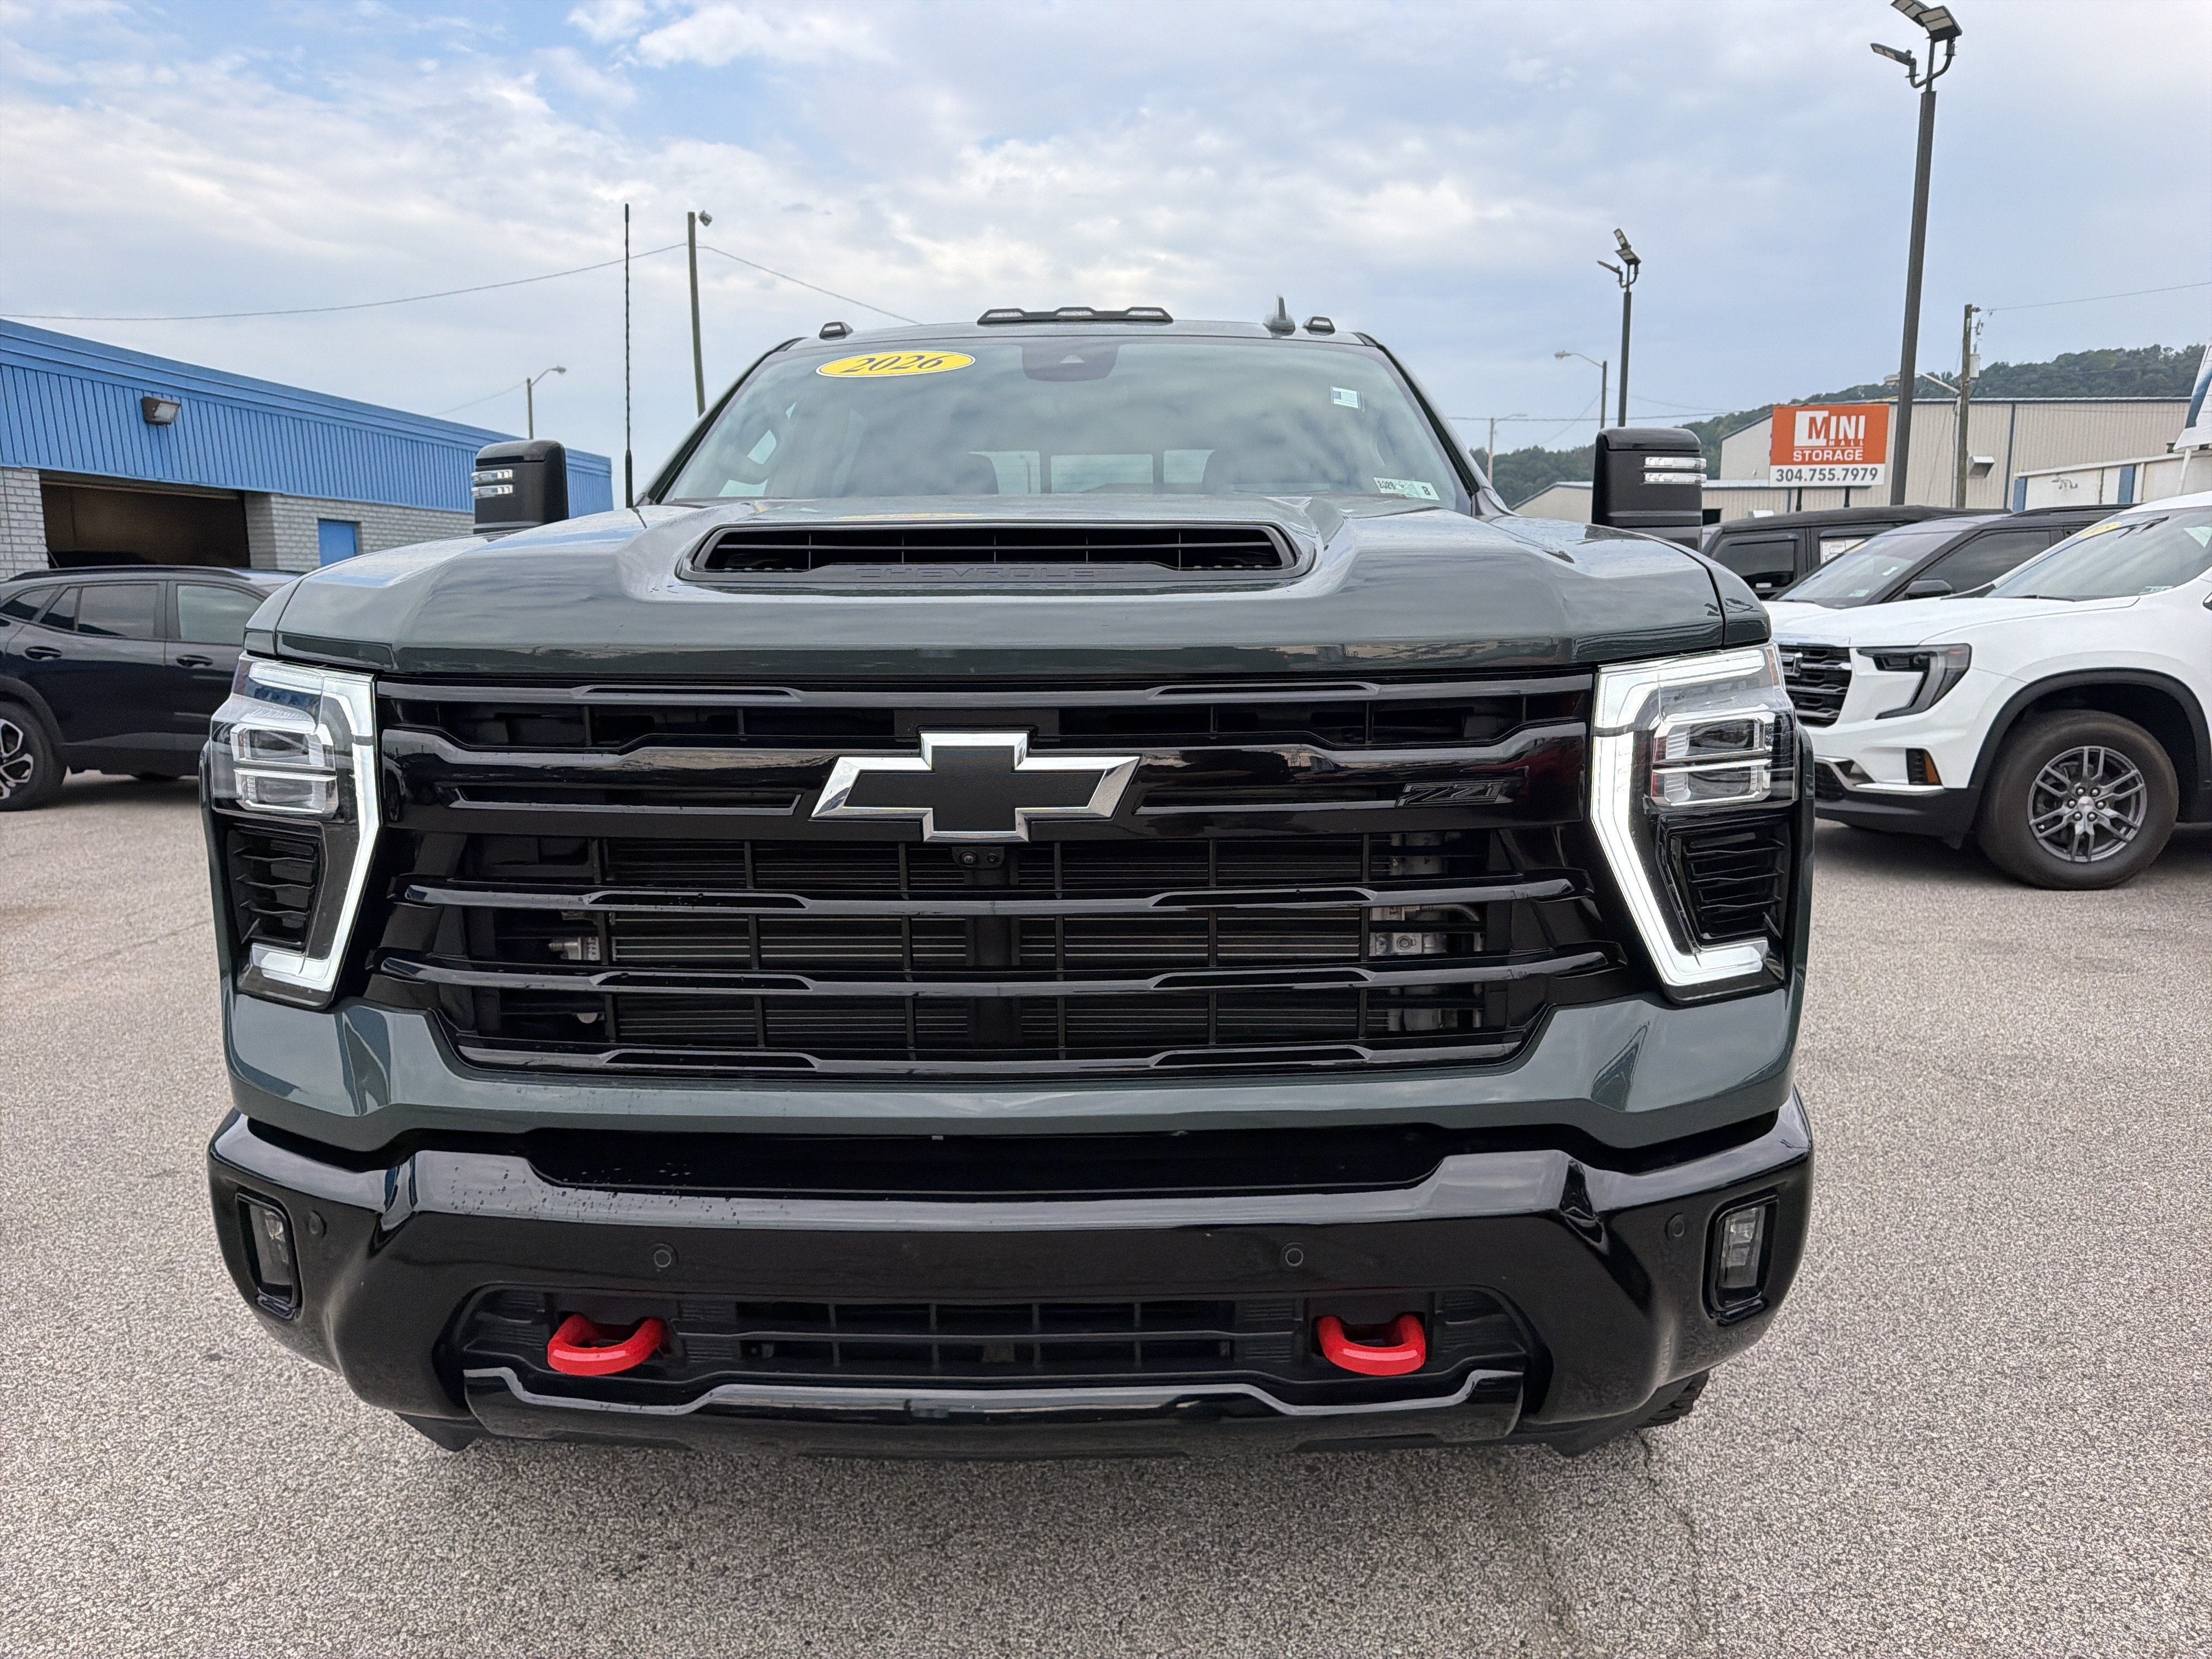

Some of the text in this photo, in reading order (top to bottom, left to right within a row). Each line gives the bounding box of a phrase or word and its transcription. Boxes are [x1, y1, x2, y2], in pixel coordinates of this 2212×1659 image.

[839, 354, 955, 374] 2026
[1803, 413, 1865, 441] MINI
[1793, 450, 1864, 462] STORAGE
[1776, 467, 1878, 482] 304.755.7979
[854, 568, 1125, 582] CHEVROLET
